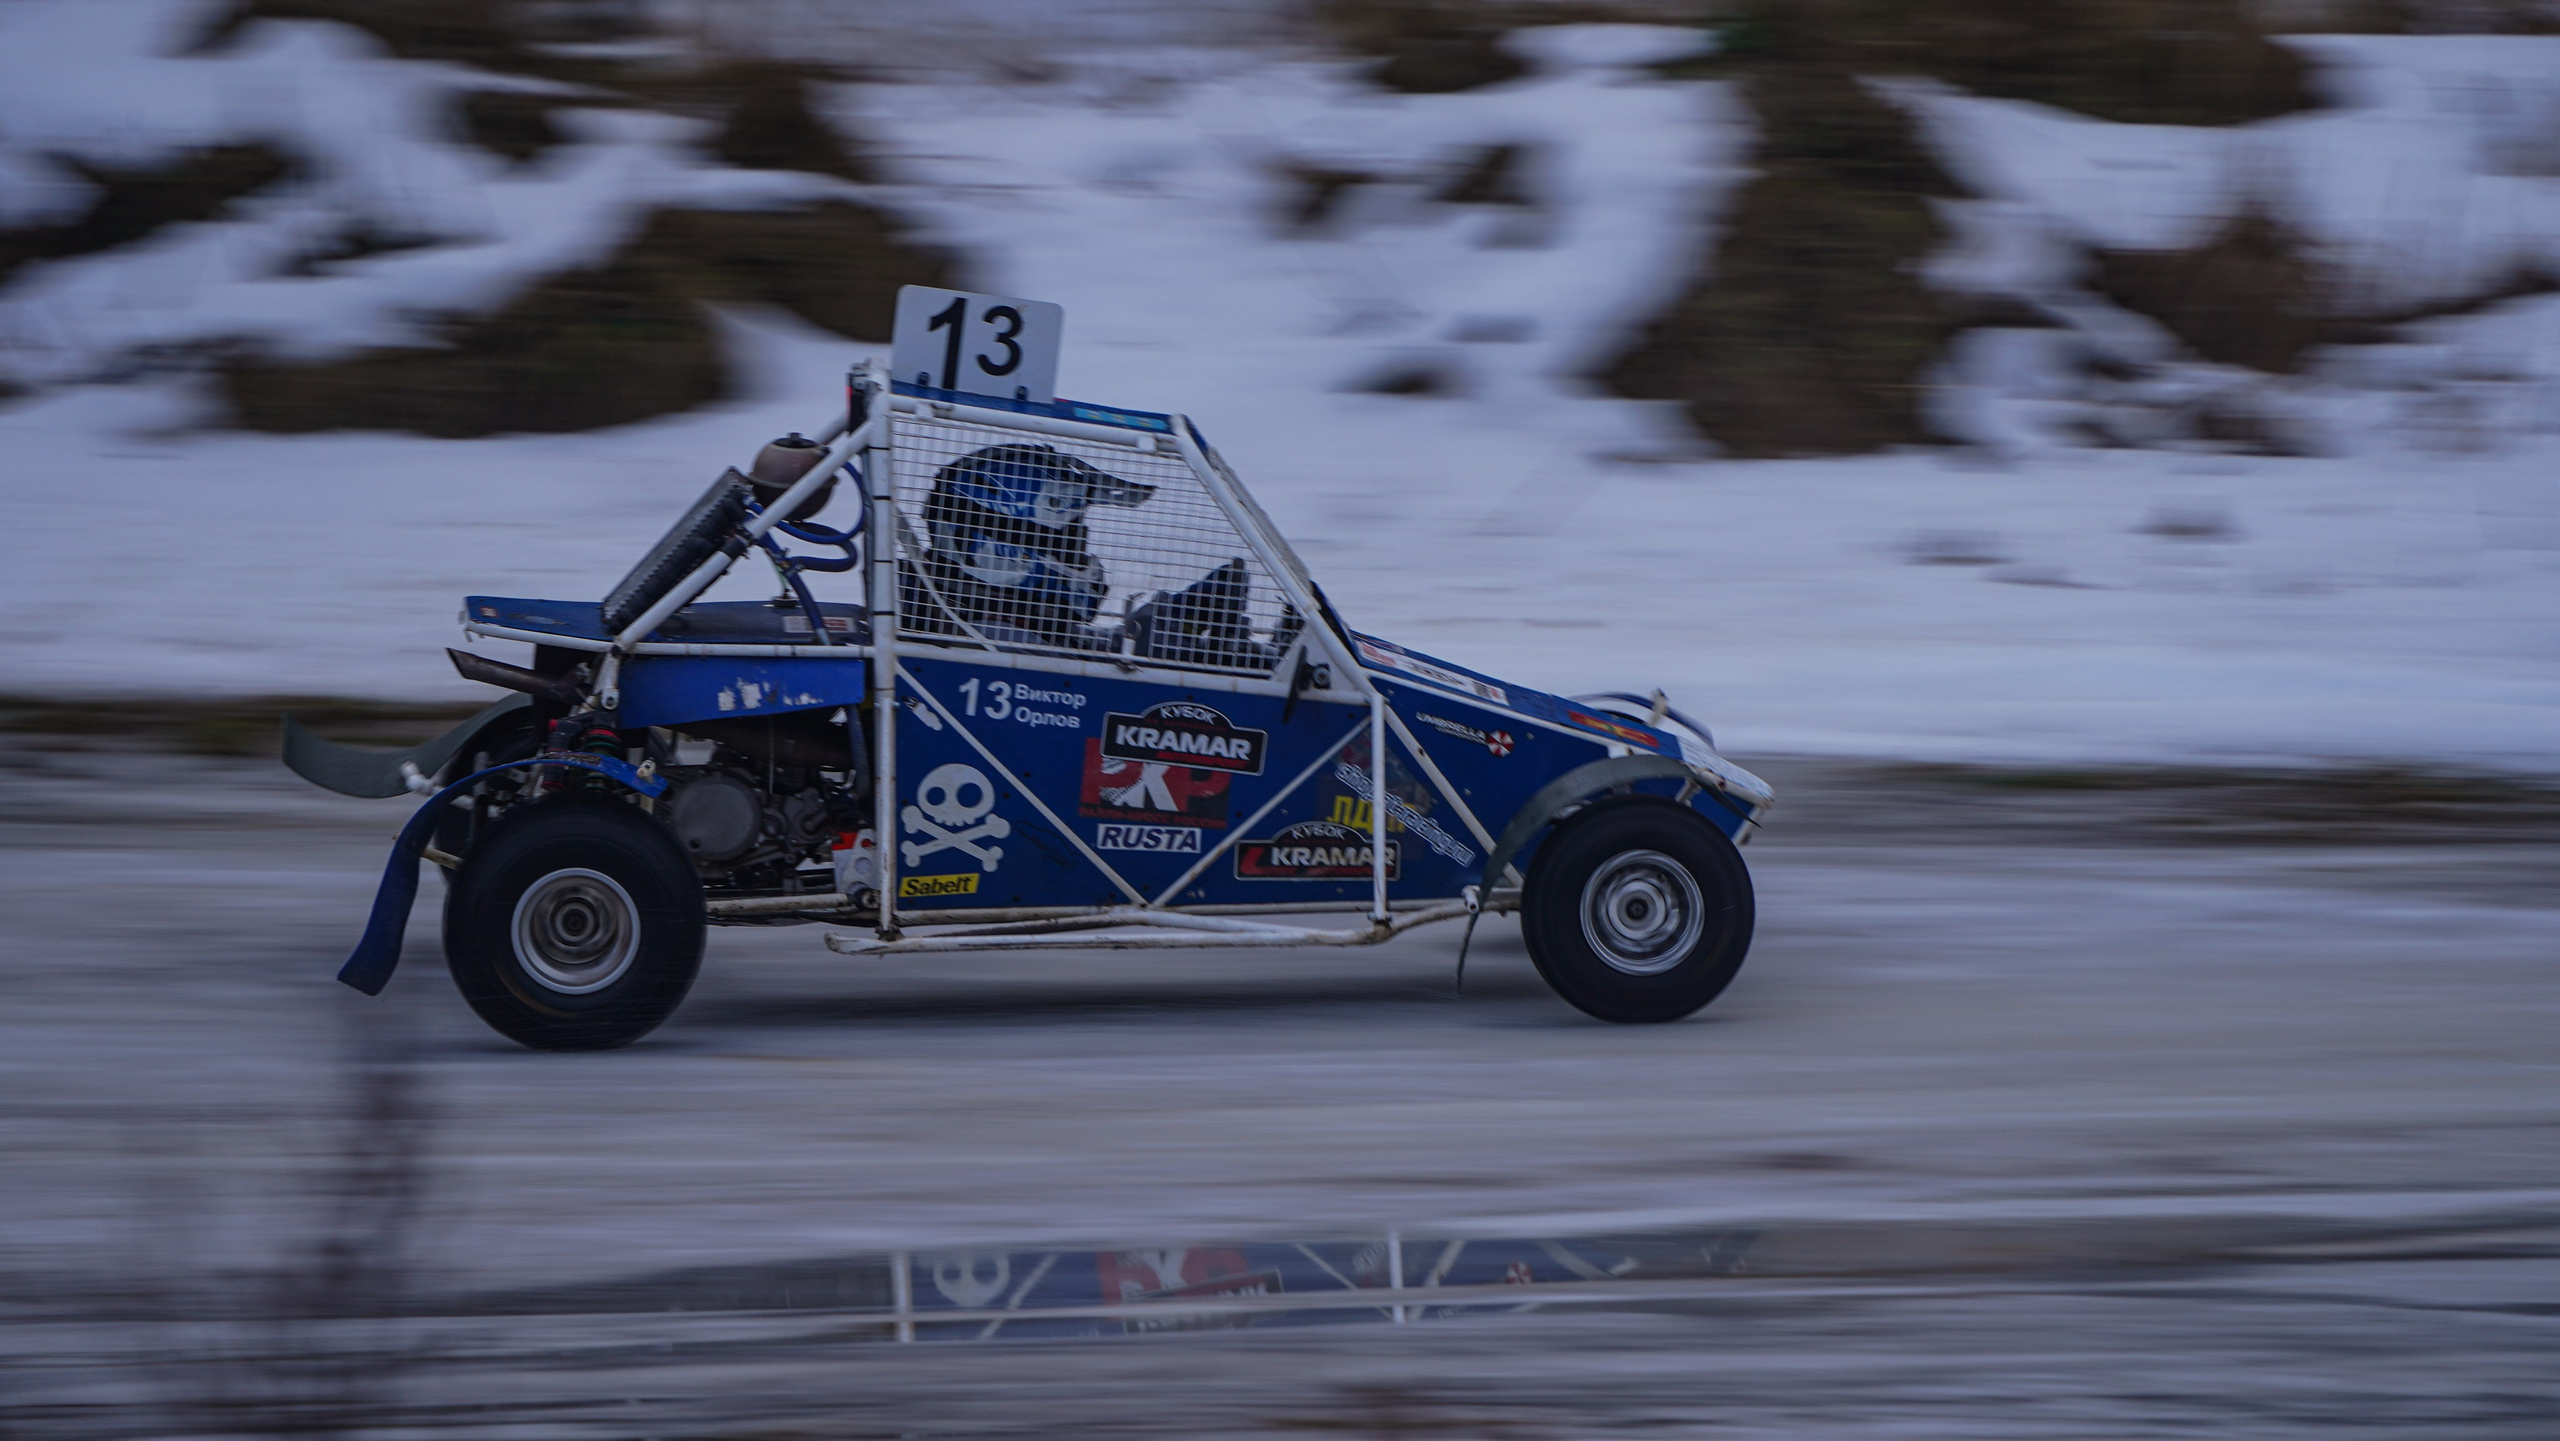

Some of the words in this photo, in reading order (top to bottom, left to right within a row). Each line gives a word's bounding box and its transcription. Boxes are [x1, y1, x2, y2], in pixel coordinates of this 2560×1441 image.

[927, 297, 1024, 390] 13
[958, 677, 1013, 720] 13
[1014, 683, 1087, 709] Виктор
[1014, 707, 1081, 729] Орлов
[1115, 724, 1253, 761] KRAMAR
[1101, 826, 1200, 850] RUSTA
[904, 876, 972, 895] Sabelt
